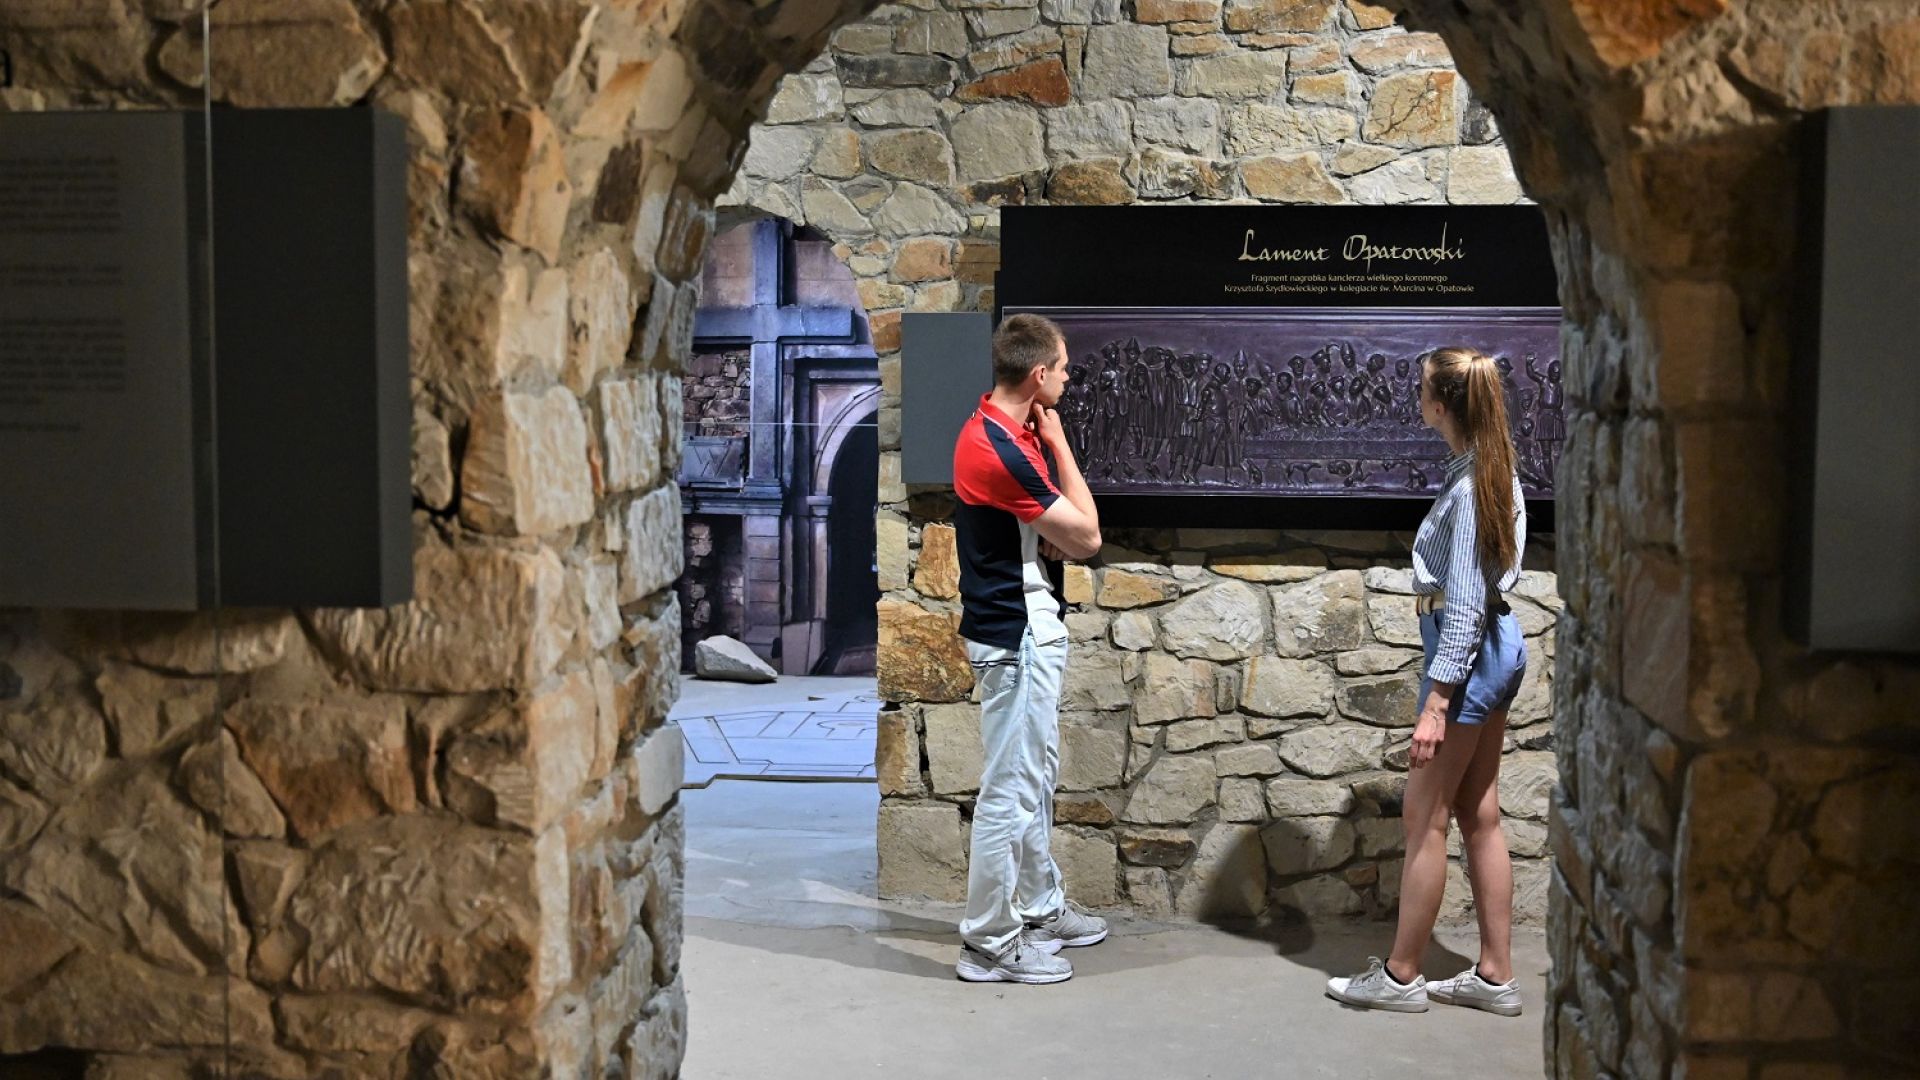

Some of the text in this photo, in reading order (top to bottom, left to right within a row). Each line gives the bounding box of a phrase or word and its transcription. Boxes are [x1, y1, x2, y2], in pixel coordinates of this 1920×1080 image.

[1238, 221, 1466, 273] Lament Opatowski
[1251, 274, 1448, 284] Fragment nagrobka kanclerza wielkiego koronnego
[1224, 284, 1264, 294] Krzysztofa
[1265, 284, 1329, 294] Szydłowieckiego
[1339, 284, 1378, 294] kolegiacie
[1379, 284, 1391, 292] św.
[1393, 284, 1426, 292] Marcina
[1435, 284, 1475, 294] Opatowie
